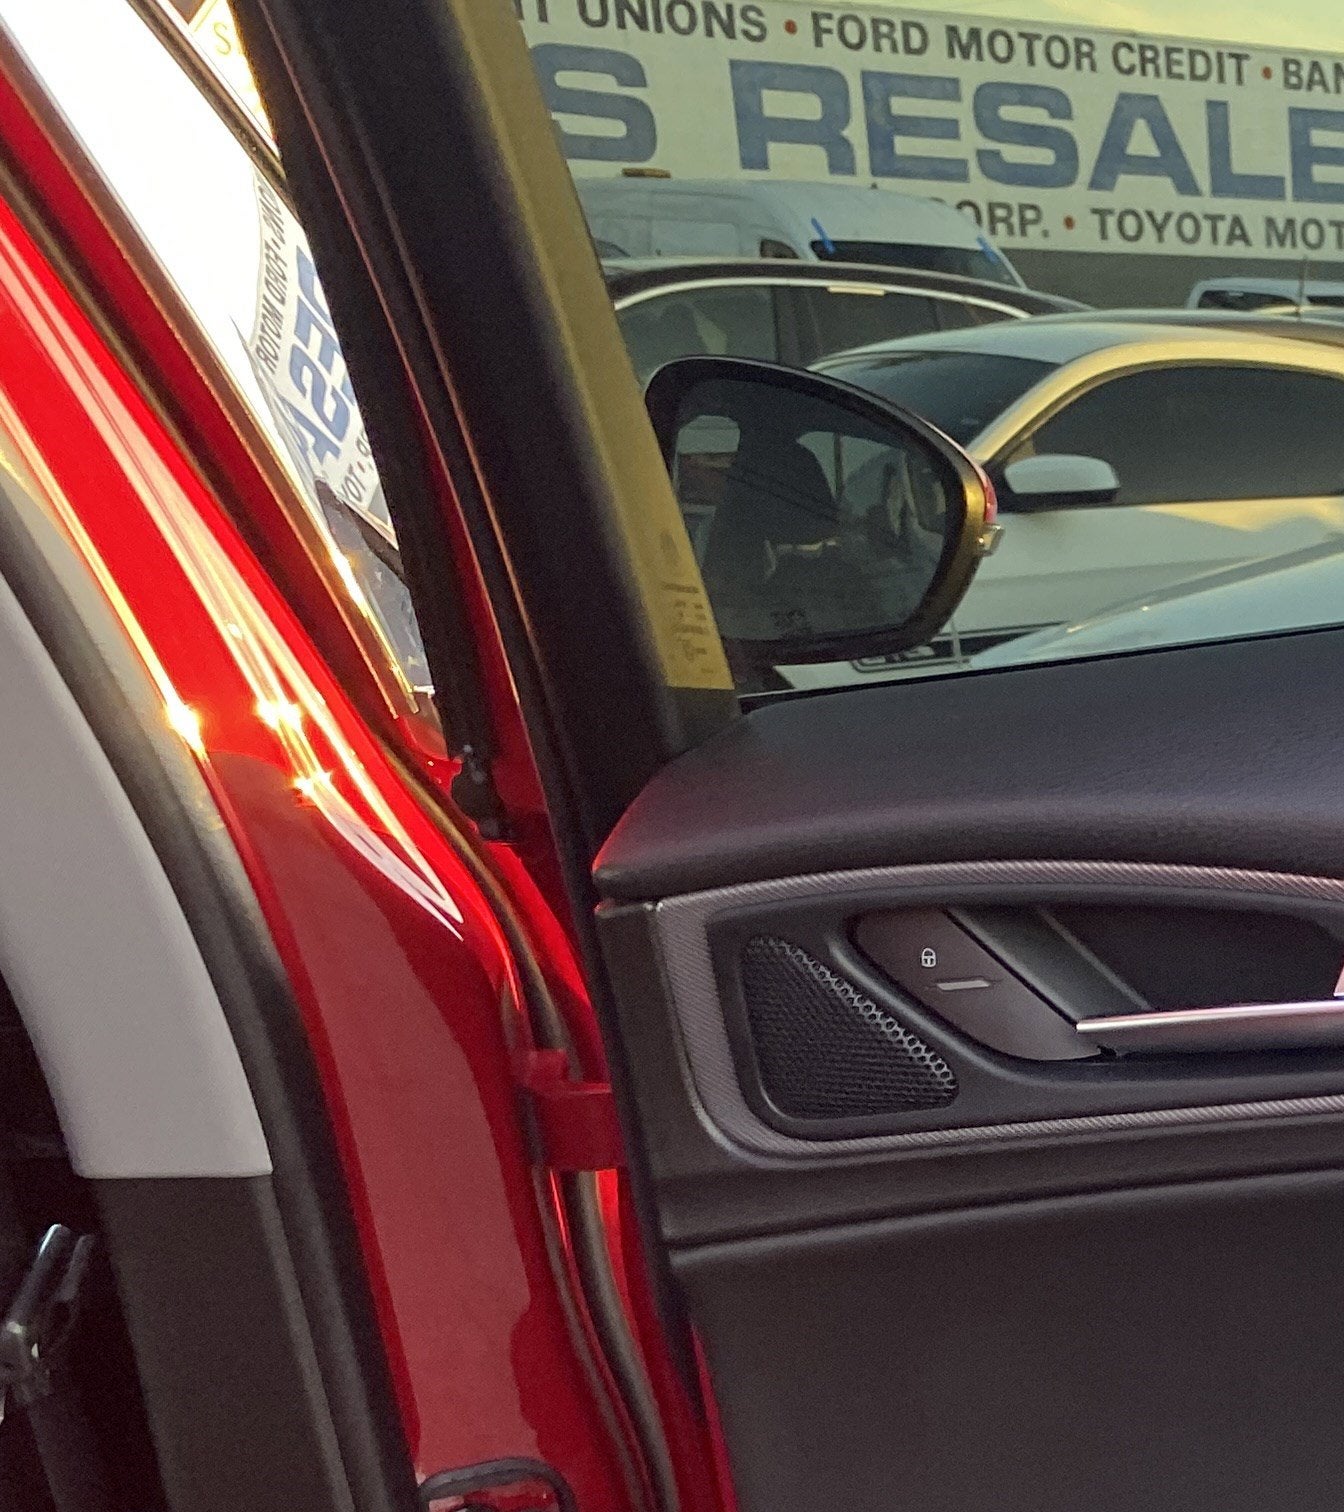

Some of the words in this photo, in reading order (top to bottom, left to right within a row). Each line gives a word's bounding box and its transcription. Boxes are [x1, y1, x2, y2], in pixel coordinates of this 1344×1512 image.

[577, 0, 767, 43] UNIONS
[811, 10, 929, 56] FORD
[945, 24, 1098, 73] MOTOR
[1111, 41, 1250, 86] CREDIT
[1090, 207, 1252, 247] TOYOTA
